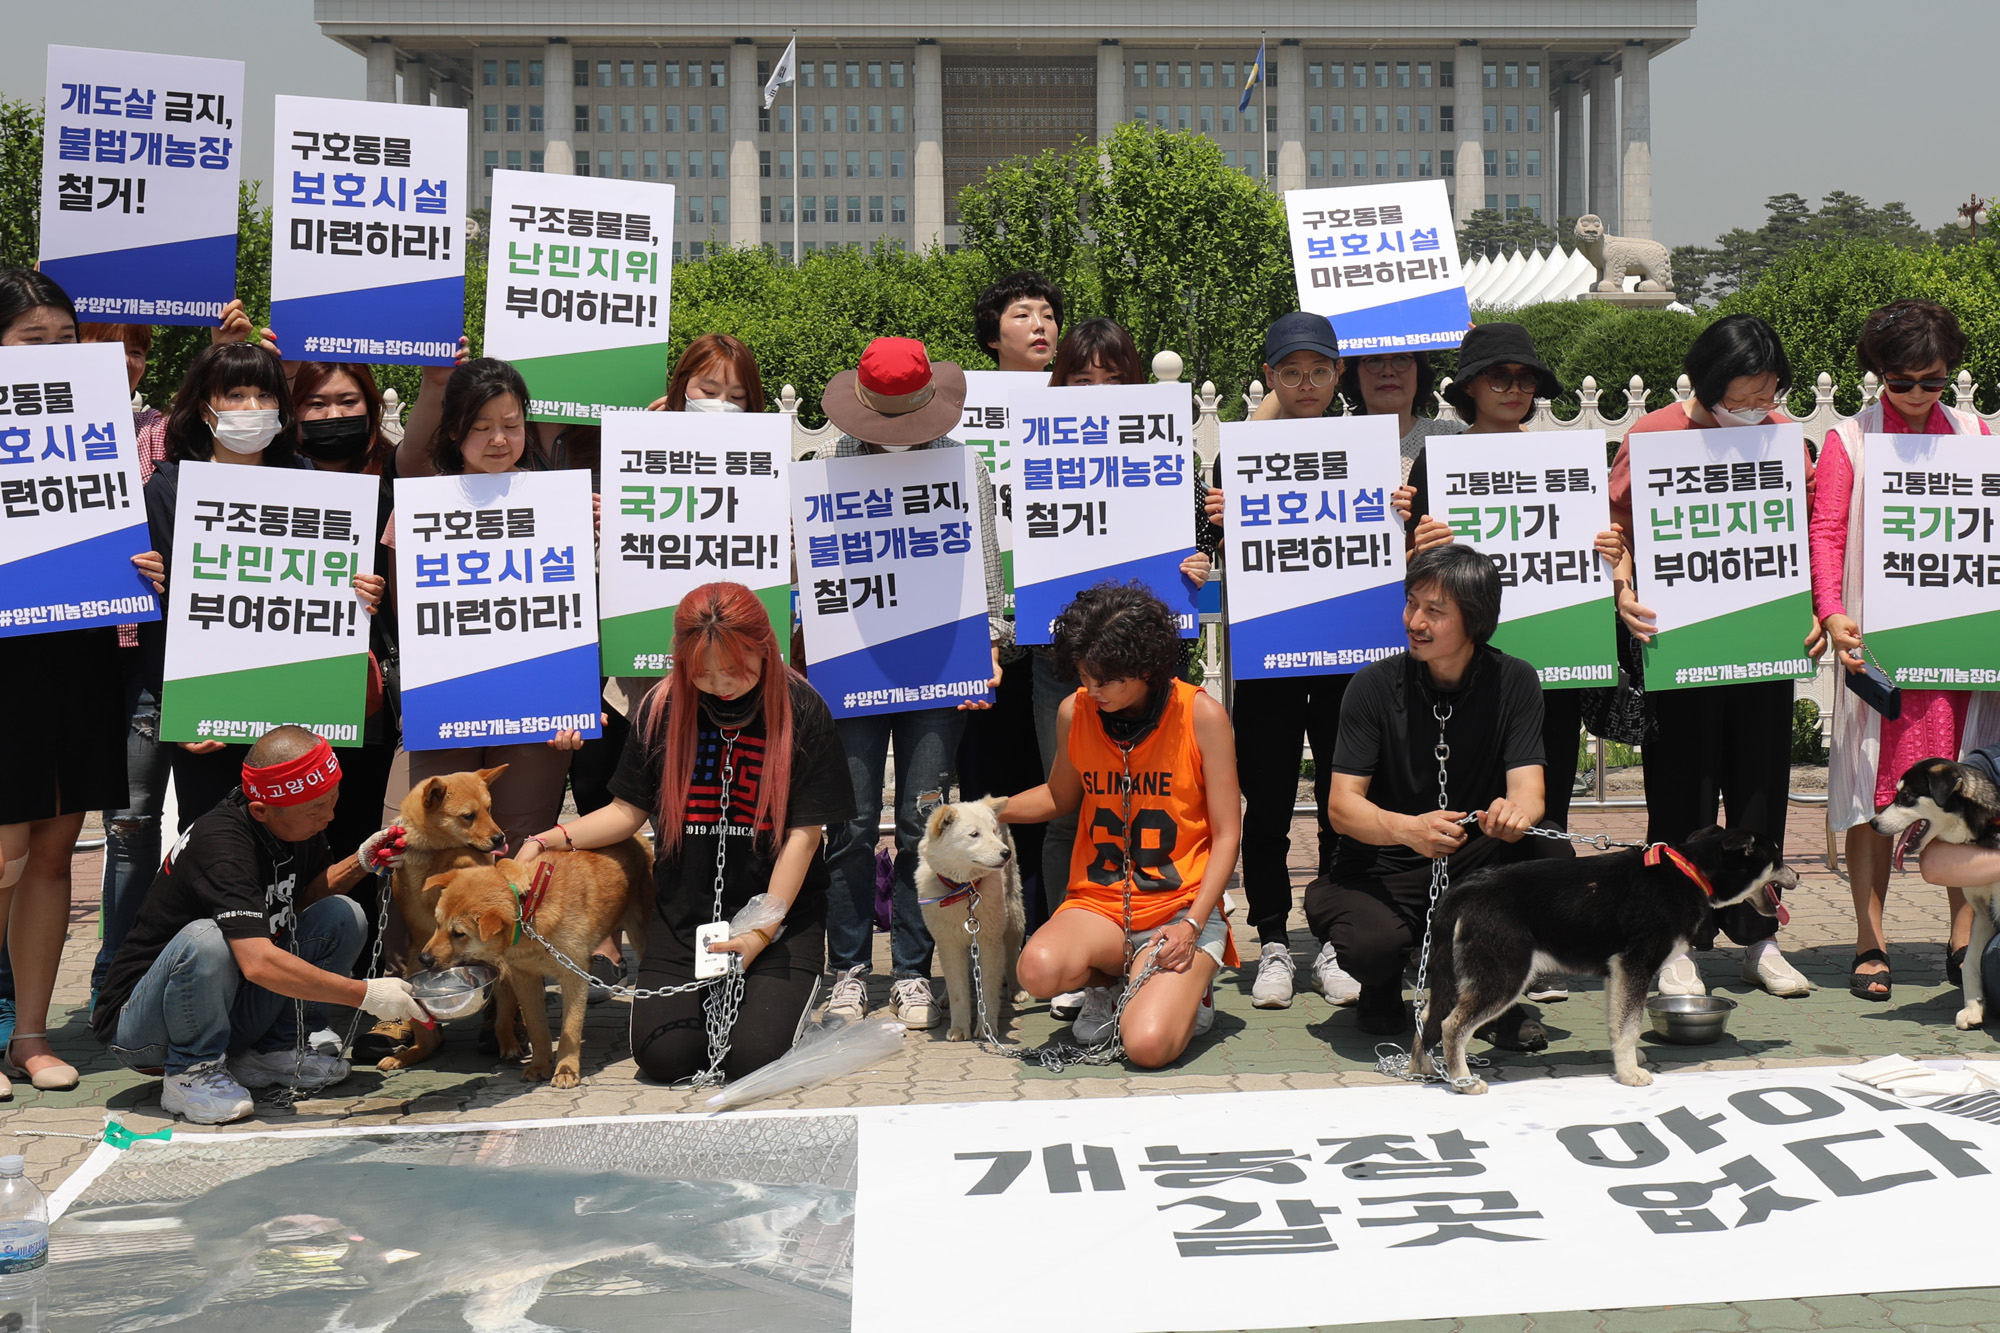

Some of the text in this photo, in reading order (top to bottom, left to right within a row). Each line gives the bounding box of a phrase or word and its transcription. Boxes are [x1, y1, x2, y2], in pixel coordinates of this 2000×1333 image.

[61, 83, 232, 129] 개도살 금지,
[59, 126, 232, 169] 불법개농장
[291, 131, 411, 167] 구호동물
[58, 173, 146, 214] 철거!
[292, 171, 447, 214] 보호시설
[509, 204, 658, 246] 구조동물들,
[1302, 205, 1403, 230] 구호동물
[290, 218, 451, 260] 마련하라!
[1307, 228, 1440, 259] 보호시설
[508, 242, 657, 284] 난민지위
[1310, 257, 1450, 288] 마련하라!
[506, 286, 657, 327] 부여하라!
[304, 337, 457, 358] #양산개농장64아이
[0, 422, 118, 464] 호시설
[1022, 414, 1183, 446] 개도살 금지,
[620, 450, 779, 479] 고통받는 동물,
[1024, 454, 1185, 490] 불법개농장
[1237, 451, 1348, 483] 구호동물
[1446, 468, 1597, 495] 고통받는 동물,
[1648, 460, 1792, 496] 구조동물들,
[1882, 471, 1973, 496] 고통받는
[620, 486, 738, 523] 국가가
[804, 488, 894, 523] 개도살
[902, 481, 969, 515] 금지,
[1026, 501, 1107, 538] 철거!
[1240, 487, 1385, 526] 보호시설
[1650, 498, 1794, 541] 난민지위
[194, 500, 359, 545] 구조동물들,
[413, 508, 535, 542] 구호동물
[1448, 504, 1559, 542] 국가가
[1882, 506, 1994, 542] 국가가
[620, 533, 779, 570] 책임져라!
[809, 521, 972, 568] 불법개농장
[1241, 533, 1392, 573] 마련하라!
[192, 542, 358, 588] 난민지위
[416, 546, 575, 587] 보호시설
[1489, 549, 1600, 587] 임져라!
[1654, 543, 1798, 587] 부여하라!
[814, 573, 898, 615] 철거!
[188, 593, 357, 636] 부여하라!
[416, 593, 581, 636] 마련하라!
[1675, 658, 1812, 684] #양산개농장64아이
[843, 679, 989, 708] #양산개농장64아이
[438, 713, 596, 739] #양산개농장64아이
[266, 769, 325, 798] 고양이
[954, 1128, 1490, 1196] 개농장
[1607, 1122, 1993, 1234] 없다
